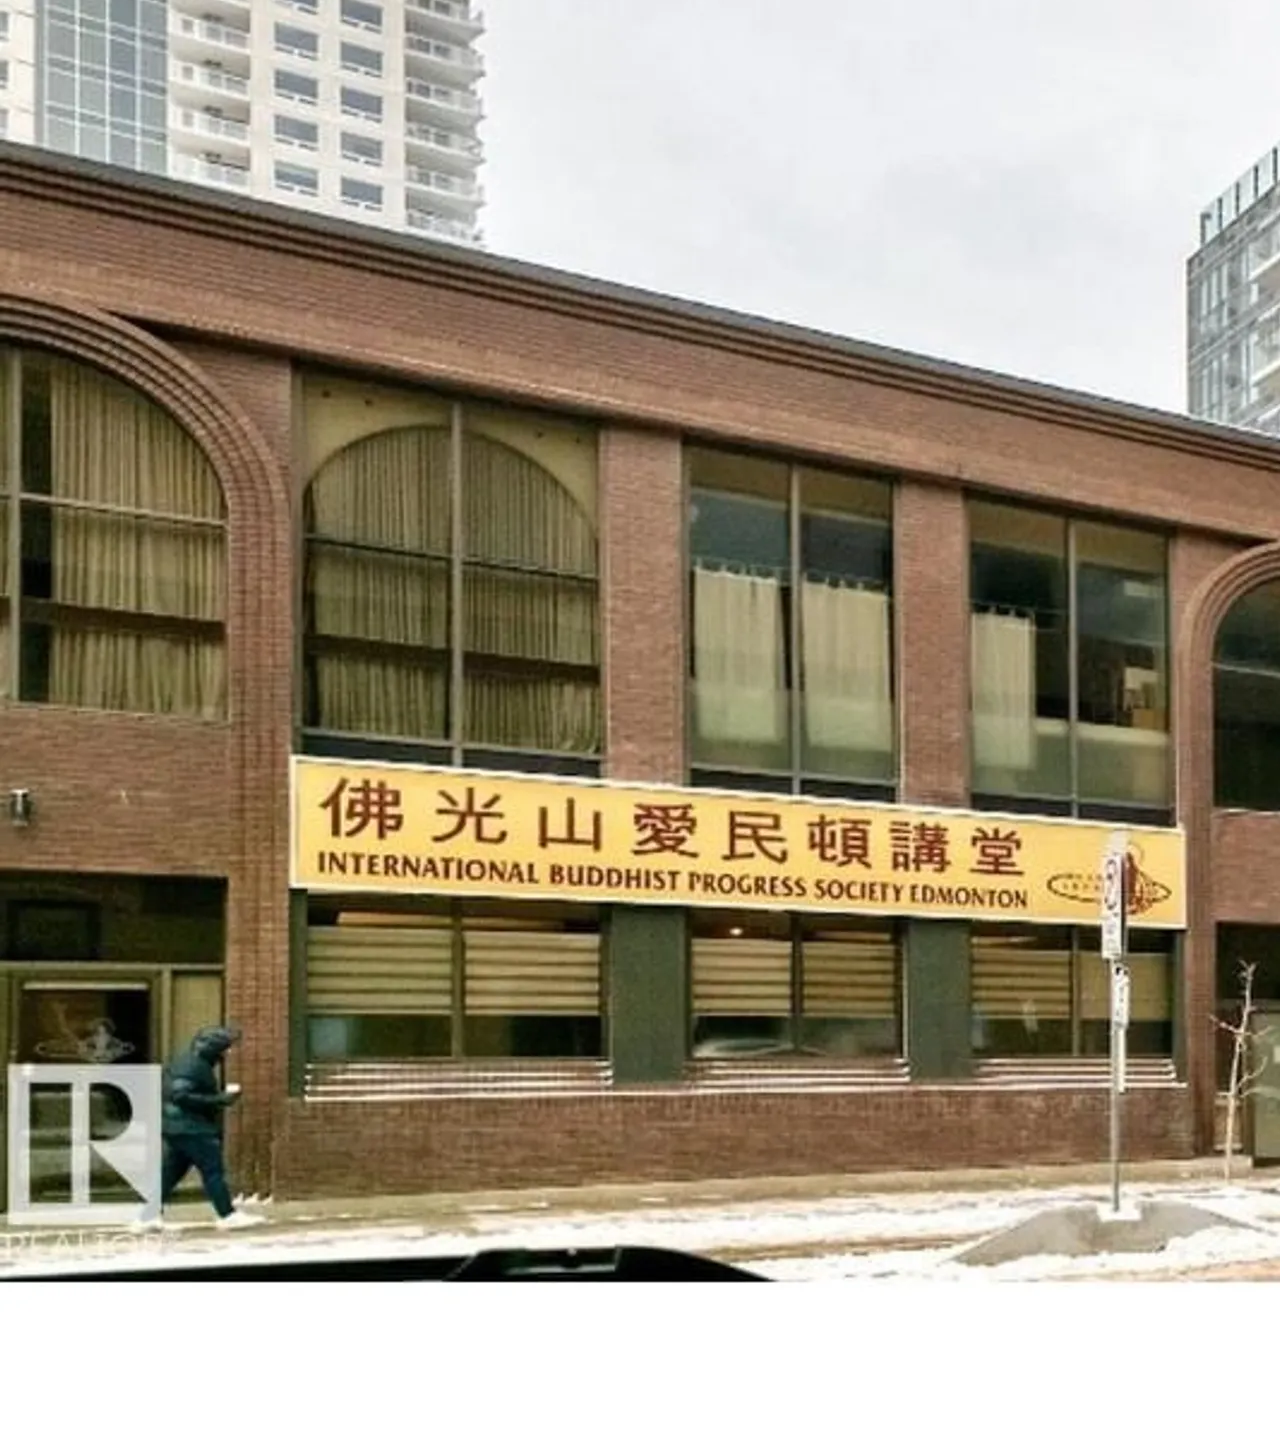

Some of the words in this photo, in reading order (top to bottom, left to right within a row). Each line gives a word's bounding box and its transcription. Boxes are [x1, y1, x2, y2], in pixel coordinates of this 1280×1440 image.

[319, 776, 1026, 876] 佛光山愛民頓講堂
[318, 850, 539, 884] INTERNATIONAL
[549, 864, 680, 893] BUDDHIST
[688, 872, 807, 897] PROGRESS
[814, 883, 905, 904] SOCIETY
[909, 885, 1028, 909] EDMONTON
